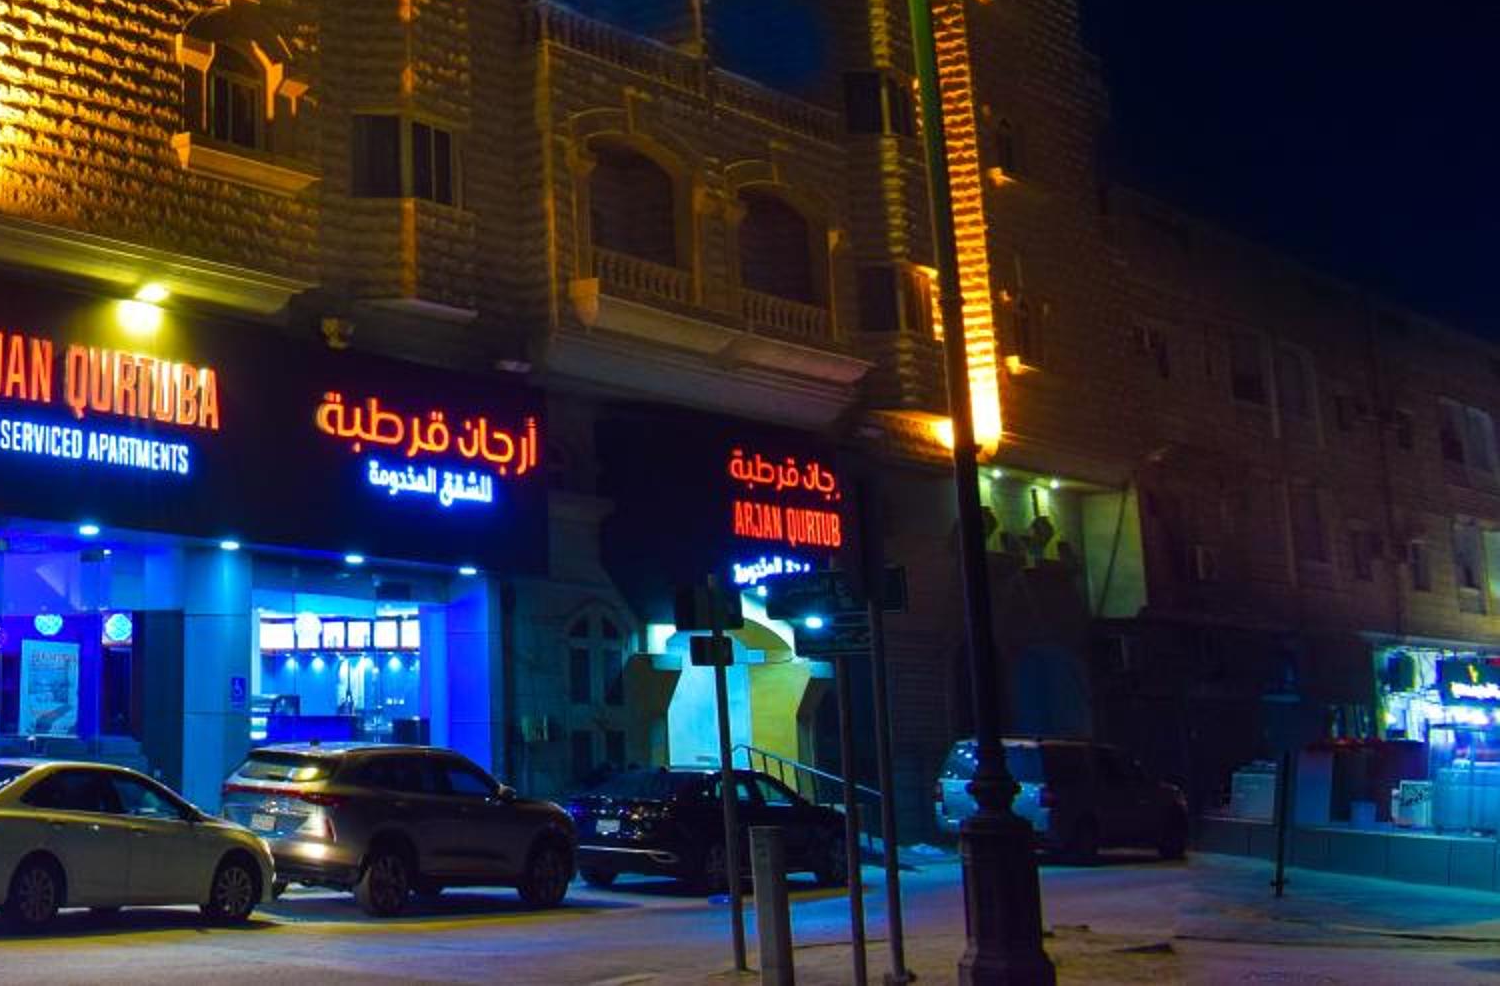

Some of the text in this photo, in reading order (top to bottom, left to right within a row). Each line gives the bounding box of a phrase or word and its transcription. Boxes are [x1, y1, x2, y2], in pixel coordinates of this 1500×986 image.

[65, 344, 219, 430] QURTUBA
[0, 418, 83, 460] SERVICED
[87, 431, 189, 475] APARTMENTS
[315, 391, 538, 475] أرجان قرطبة
[730, 449, 800, 491] قرطبة
[735, 500, 842, 548] ARJAN QURTUB
